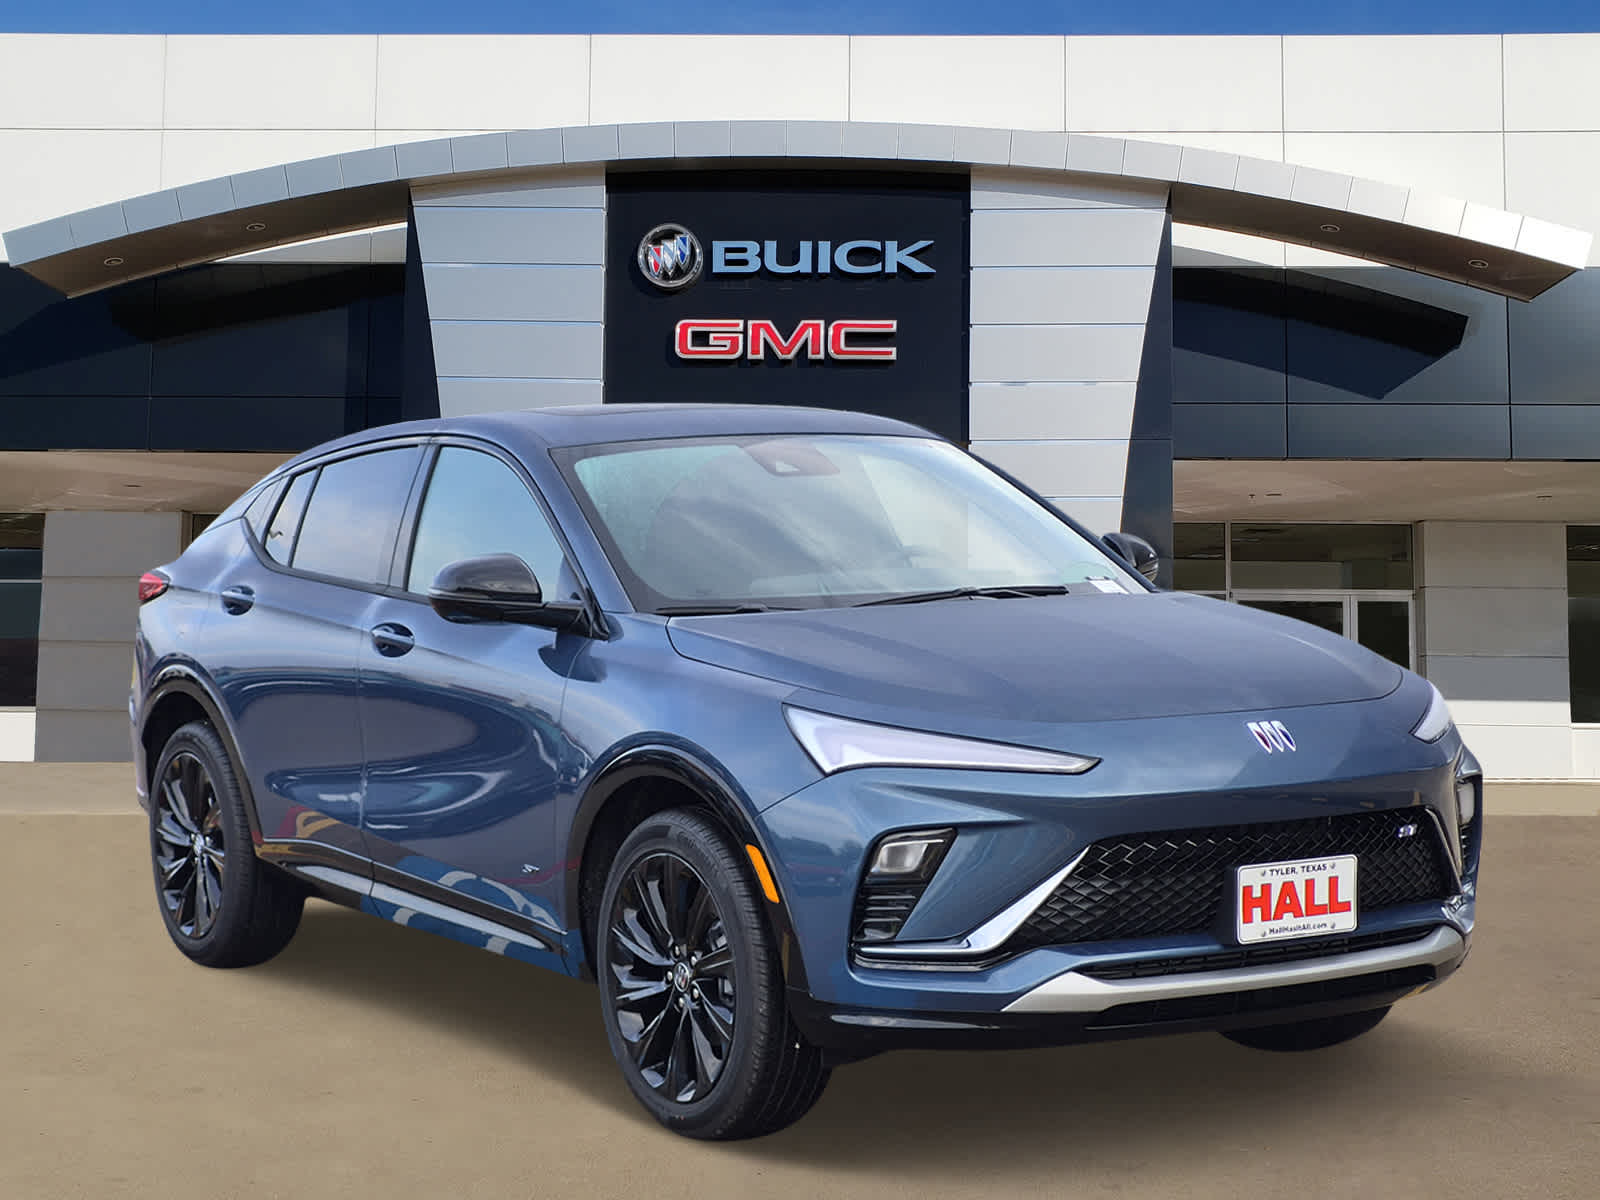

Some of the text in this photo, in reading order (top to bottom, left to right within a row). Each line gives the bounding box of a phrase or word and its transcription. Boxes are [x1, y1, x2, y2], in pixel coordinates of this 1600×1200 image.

[712, 240, 936, 274] BUICK
[675, 319, 897, 361] GMC
[1301, 864, 1328, 873] TEXAS
[1242, 876, 1351, 924] HALL
